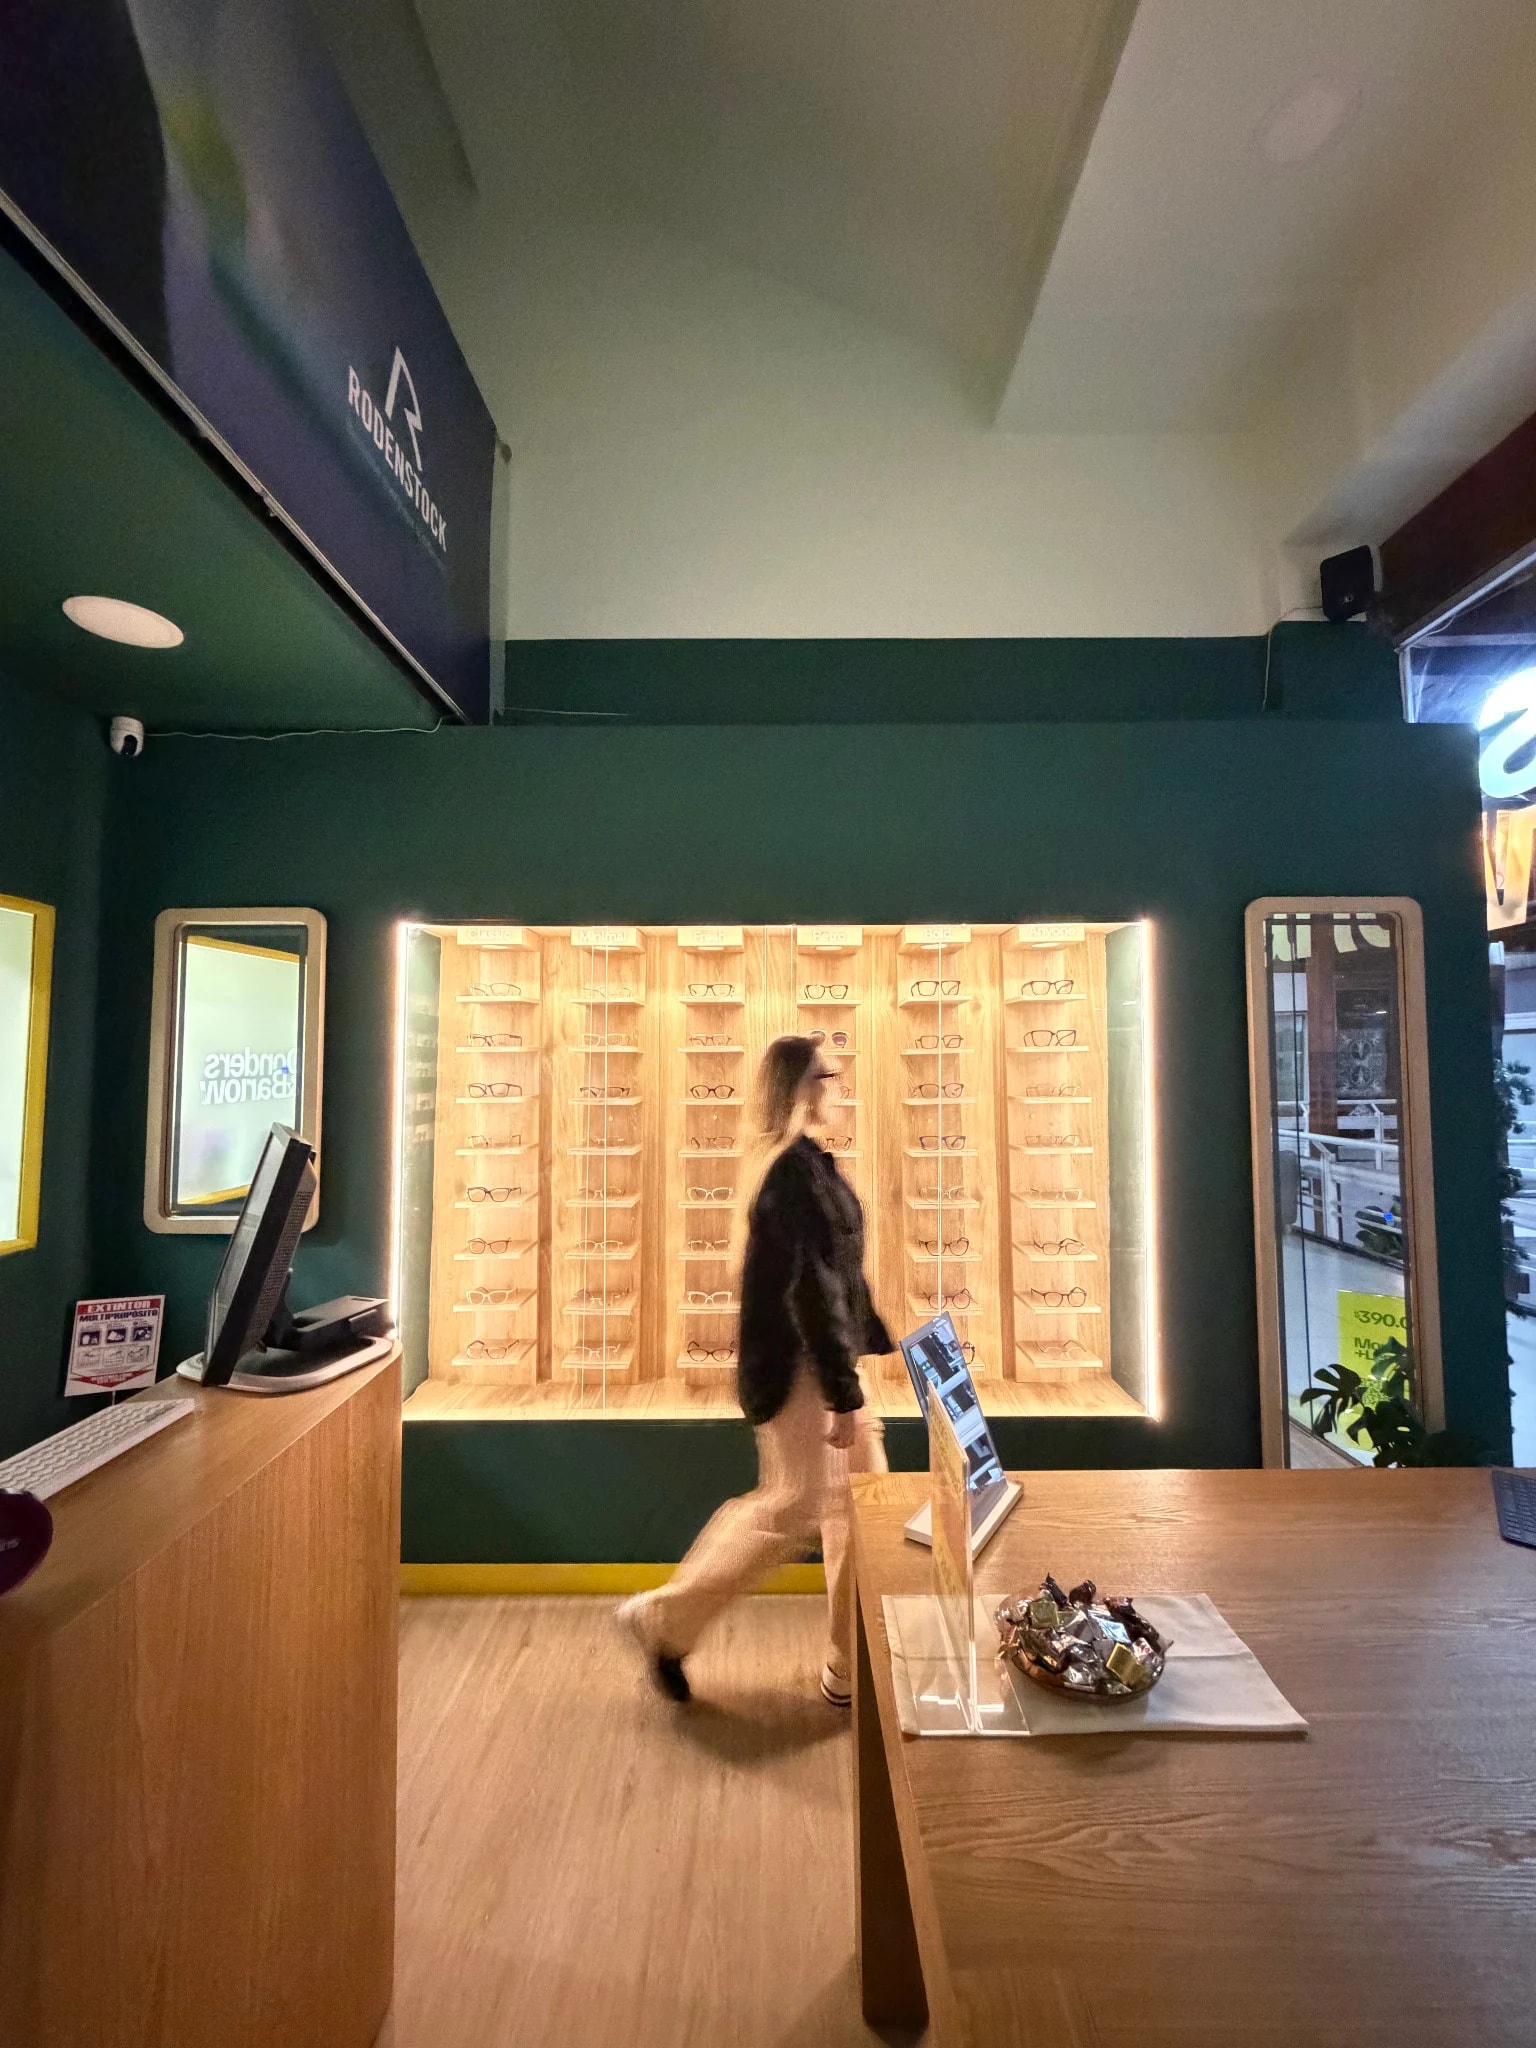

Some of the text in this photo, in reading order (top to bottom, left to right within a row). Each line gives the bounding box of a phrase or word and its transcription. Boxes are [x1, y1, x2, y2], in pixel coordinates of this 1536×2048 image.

[348, 365, 447, 551] RODENSTOCK
[924, 926, 952, 940] Bold
[1028, 925, 1076, 938] Anyone
[87, 1301, 150, 1313] EXTINTOR
